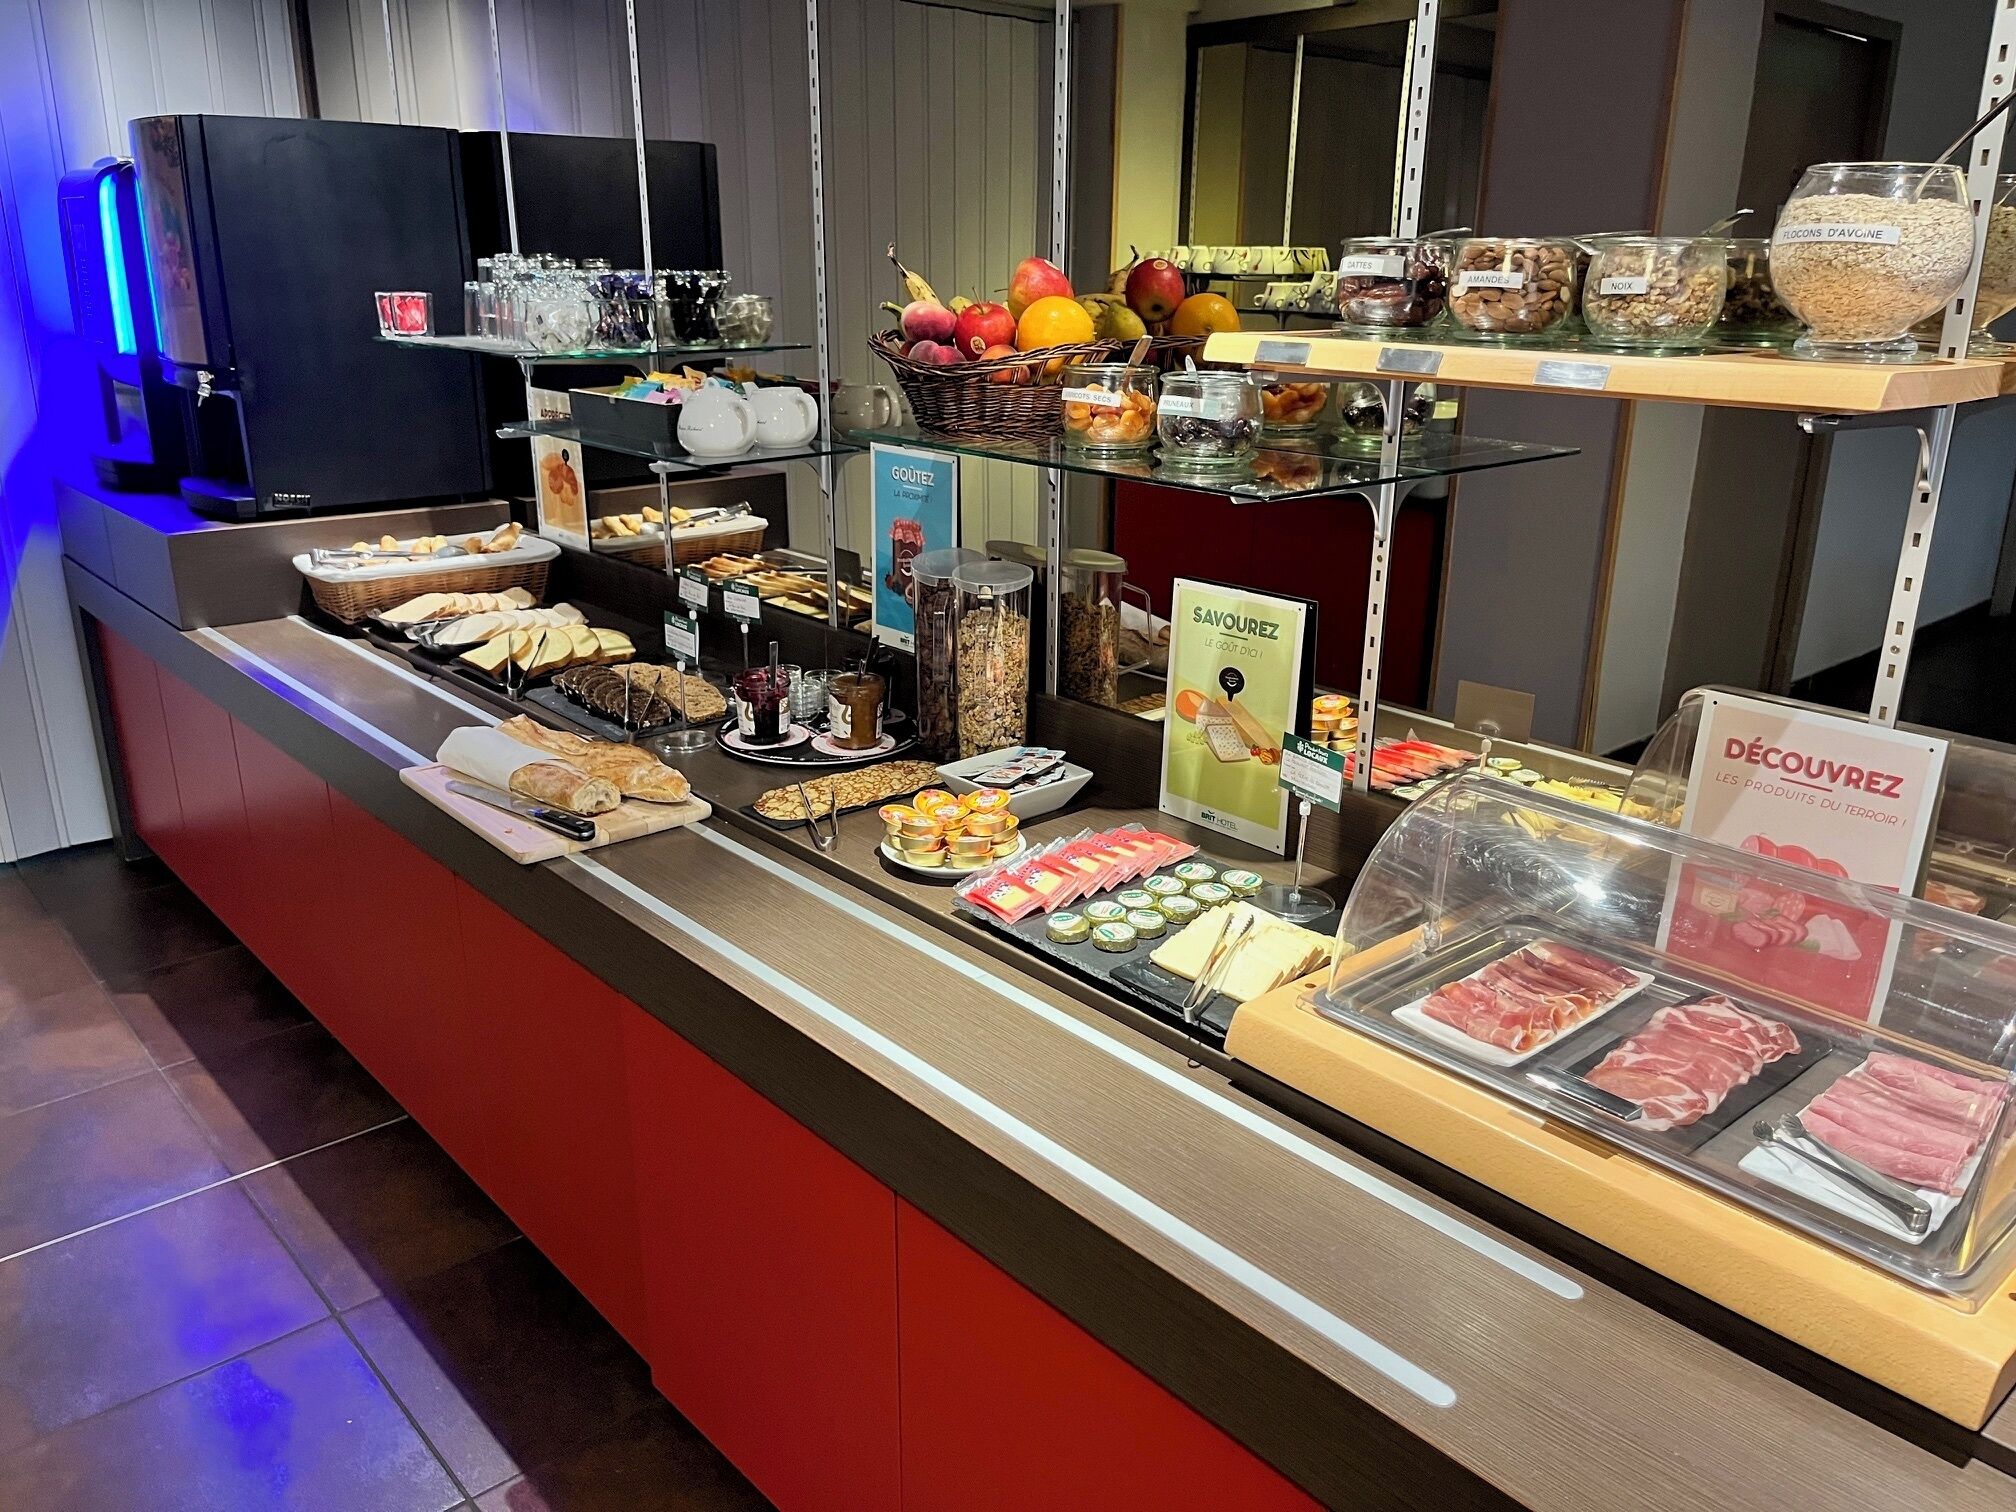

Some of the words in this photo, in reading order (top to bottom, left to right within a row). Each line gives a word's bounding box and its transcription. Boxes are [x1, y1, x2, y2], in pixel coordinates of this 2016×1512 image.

[1783, 229, 1822, 240] FLOCONS
[1827, 228, 1884, 240] D'AVOINE
[1467, 273, 1510, 285] AMANDES
[1611, 280, 1633, 291] NOIX
[1093, 393, 1112, 403] SECS
[1163, 399, 1195, 409] PRUNEAUX
[891, 465, 935, 487] GOÛTEZ
[1193, 606, 1280, 641] SAVOUREZ
[1204, 638, 1214, 648] LE
[1216, 641, 1238, 653] GOÛT
[1303, 748, 1329, 765] LOCAUX
[1723, 736, 1904, 799] DÉCOUVREZ
[1715, 771, 1738, 786] LES
[1743, 779, 1816, 806] PRODUITS
[1820, 798, 1842, 812] DU
[1844, 803, 1899, 826] TERROIR
[1216, 818, 1239, 831] HOTEL
